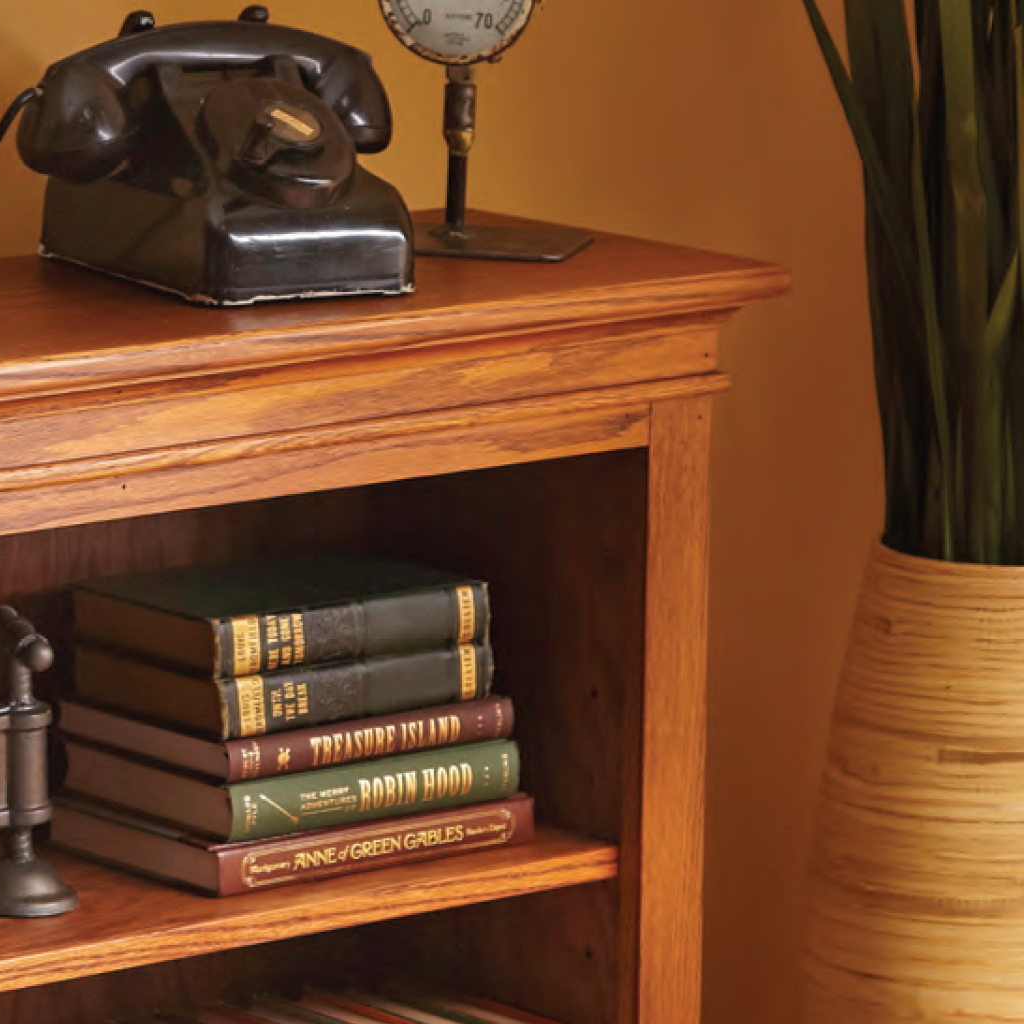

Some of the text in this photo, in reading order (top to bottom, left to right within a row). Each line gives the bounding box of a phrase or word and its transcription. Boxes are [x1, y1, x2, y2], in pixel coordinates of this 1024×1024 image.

[475, 13, 493, 29] 70
[309, 725, 396, 766] TREASURE
[401, 714, 462, 760] ISLAND
[358, 770, 418, 813] ROBIN
[422, 762, 473, 801] HOOD
[292, 847, 338, 871] ANNE
[337, 845, 351, 863] of
[350, 835, 403, 861] GREEN
[403, 824, 465, 851] GABLES
